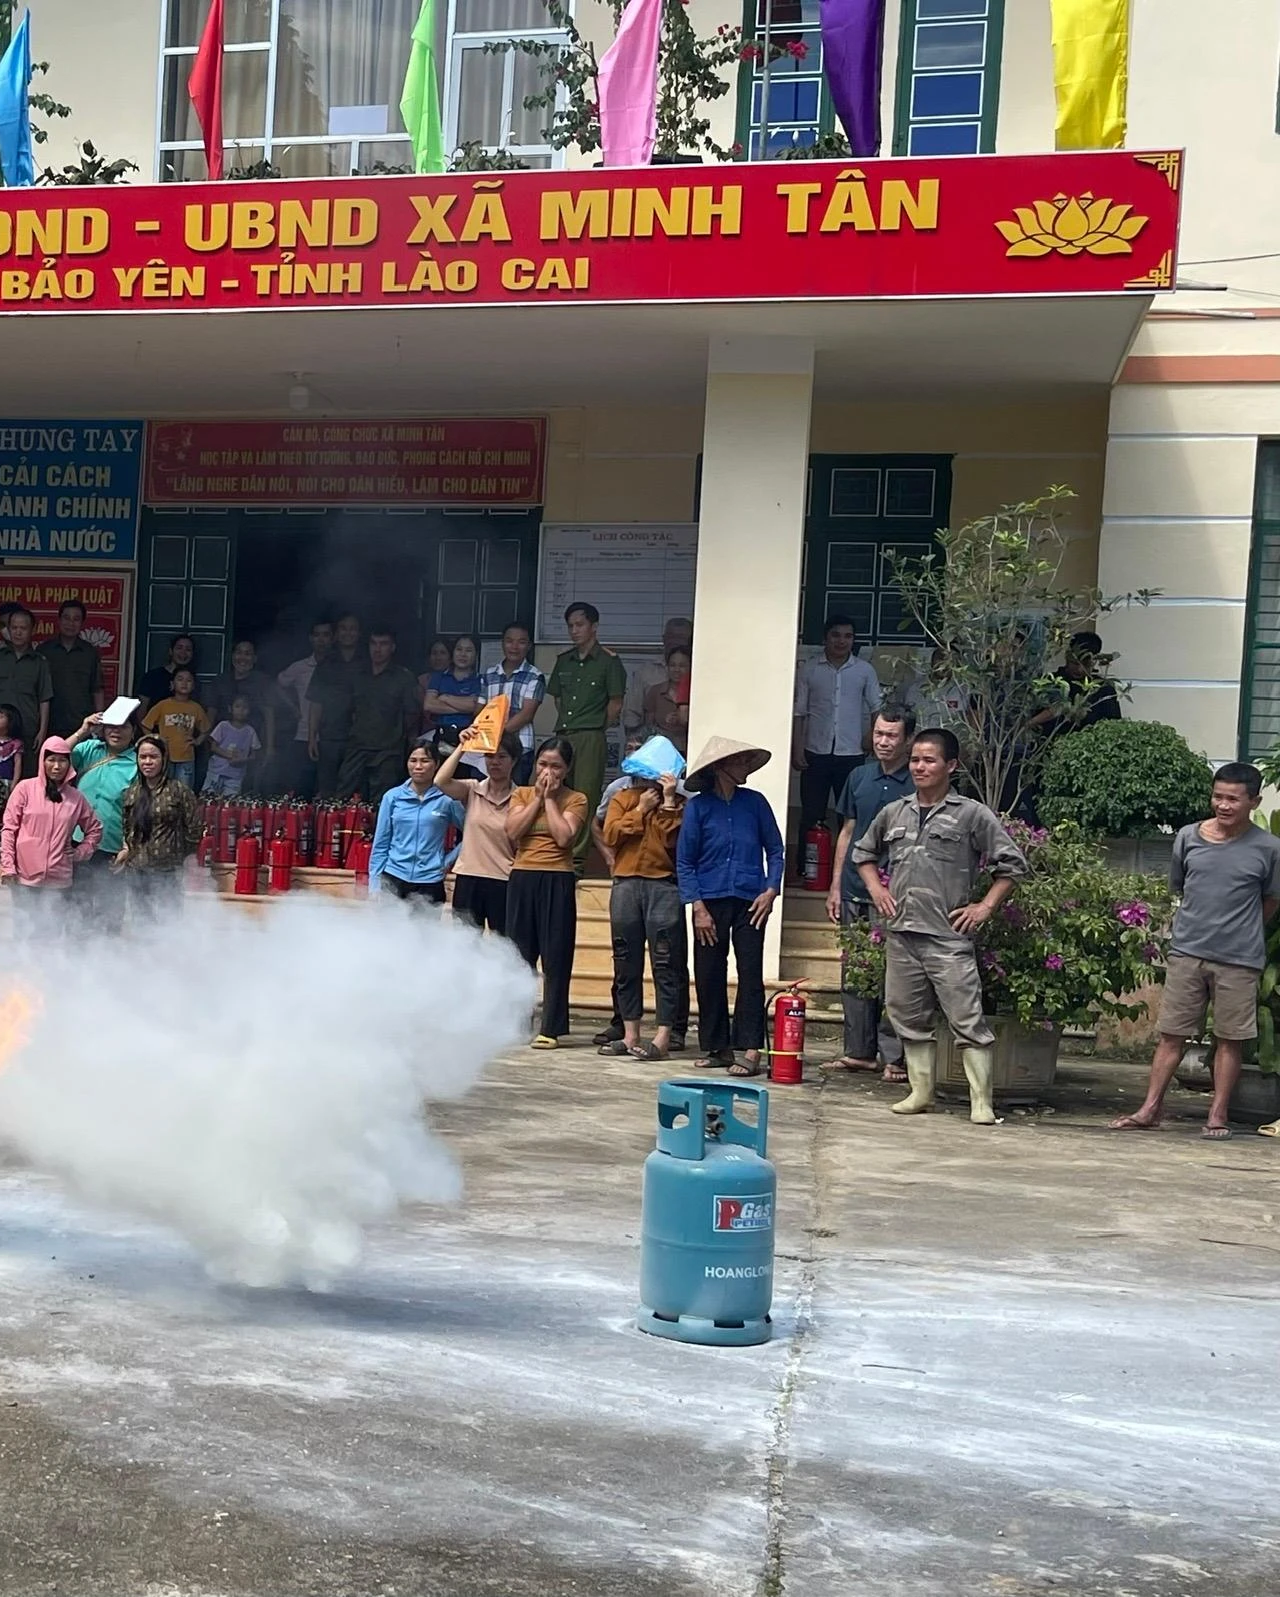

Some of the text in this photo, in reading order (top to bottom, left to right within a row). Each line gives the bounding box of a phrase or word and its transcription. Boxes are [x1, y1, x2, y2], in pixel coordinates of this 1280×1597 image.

[184, 197, 379, 251] UBND
[406, 179, 513, 244] XÃ
[539, 185, 744, 240] MINH
[776, 168, 941, 233] TÂN
[0, 257, 95, 300] BẢO
[112, 258, 205, 297] YÊN
[250, 252, 363, 295] TỈNH
[381, 251, 479, 293] LÀO
[501, 257, 590, 291] CAI
[83, 429, 139, 453] TAY
[396, 427, 423, 442] MINH
[278, 450, 302, 465] THEO
[402, 450, 437, 465] PHONG
[503, 450, 531, 466] MINH
[46, 461, 111, 487] CÁCH
[206, 475, 238, 492] NGHE
[241, 473, 266, 492] DÂN
[320, 476, 345, 493] CHO
[412, 475, 439, 494] LÀM
[442, 476, 467, 494] CHO
[471, 474, 497, 494] DÂN
[56, 492, 131, 519] CHÍNH
[49, 524, 116, 553] NƯỚC
[26, 584, 41, 603] VÀ
[45, 584, 79, 604] PHÁP
[82, 585, 114, 608] LUẬT
